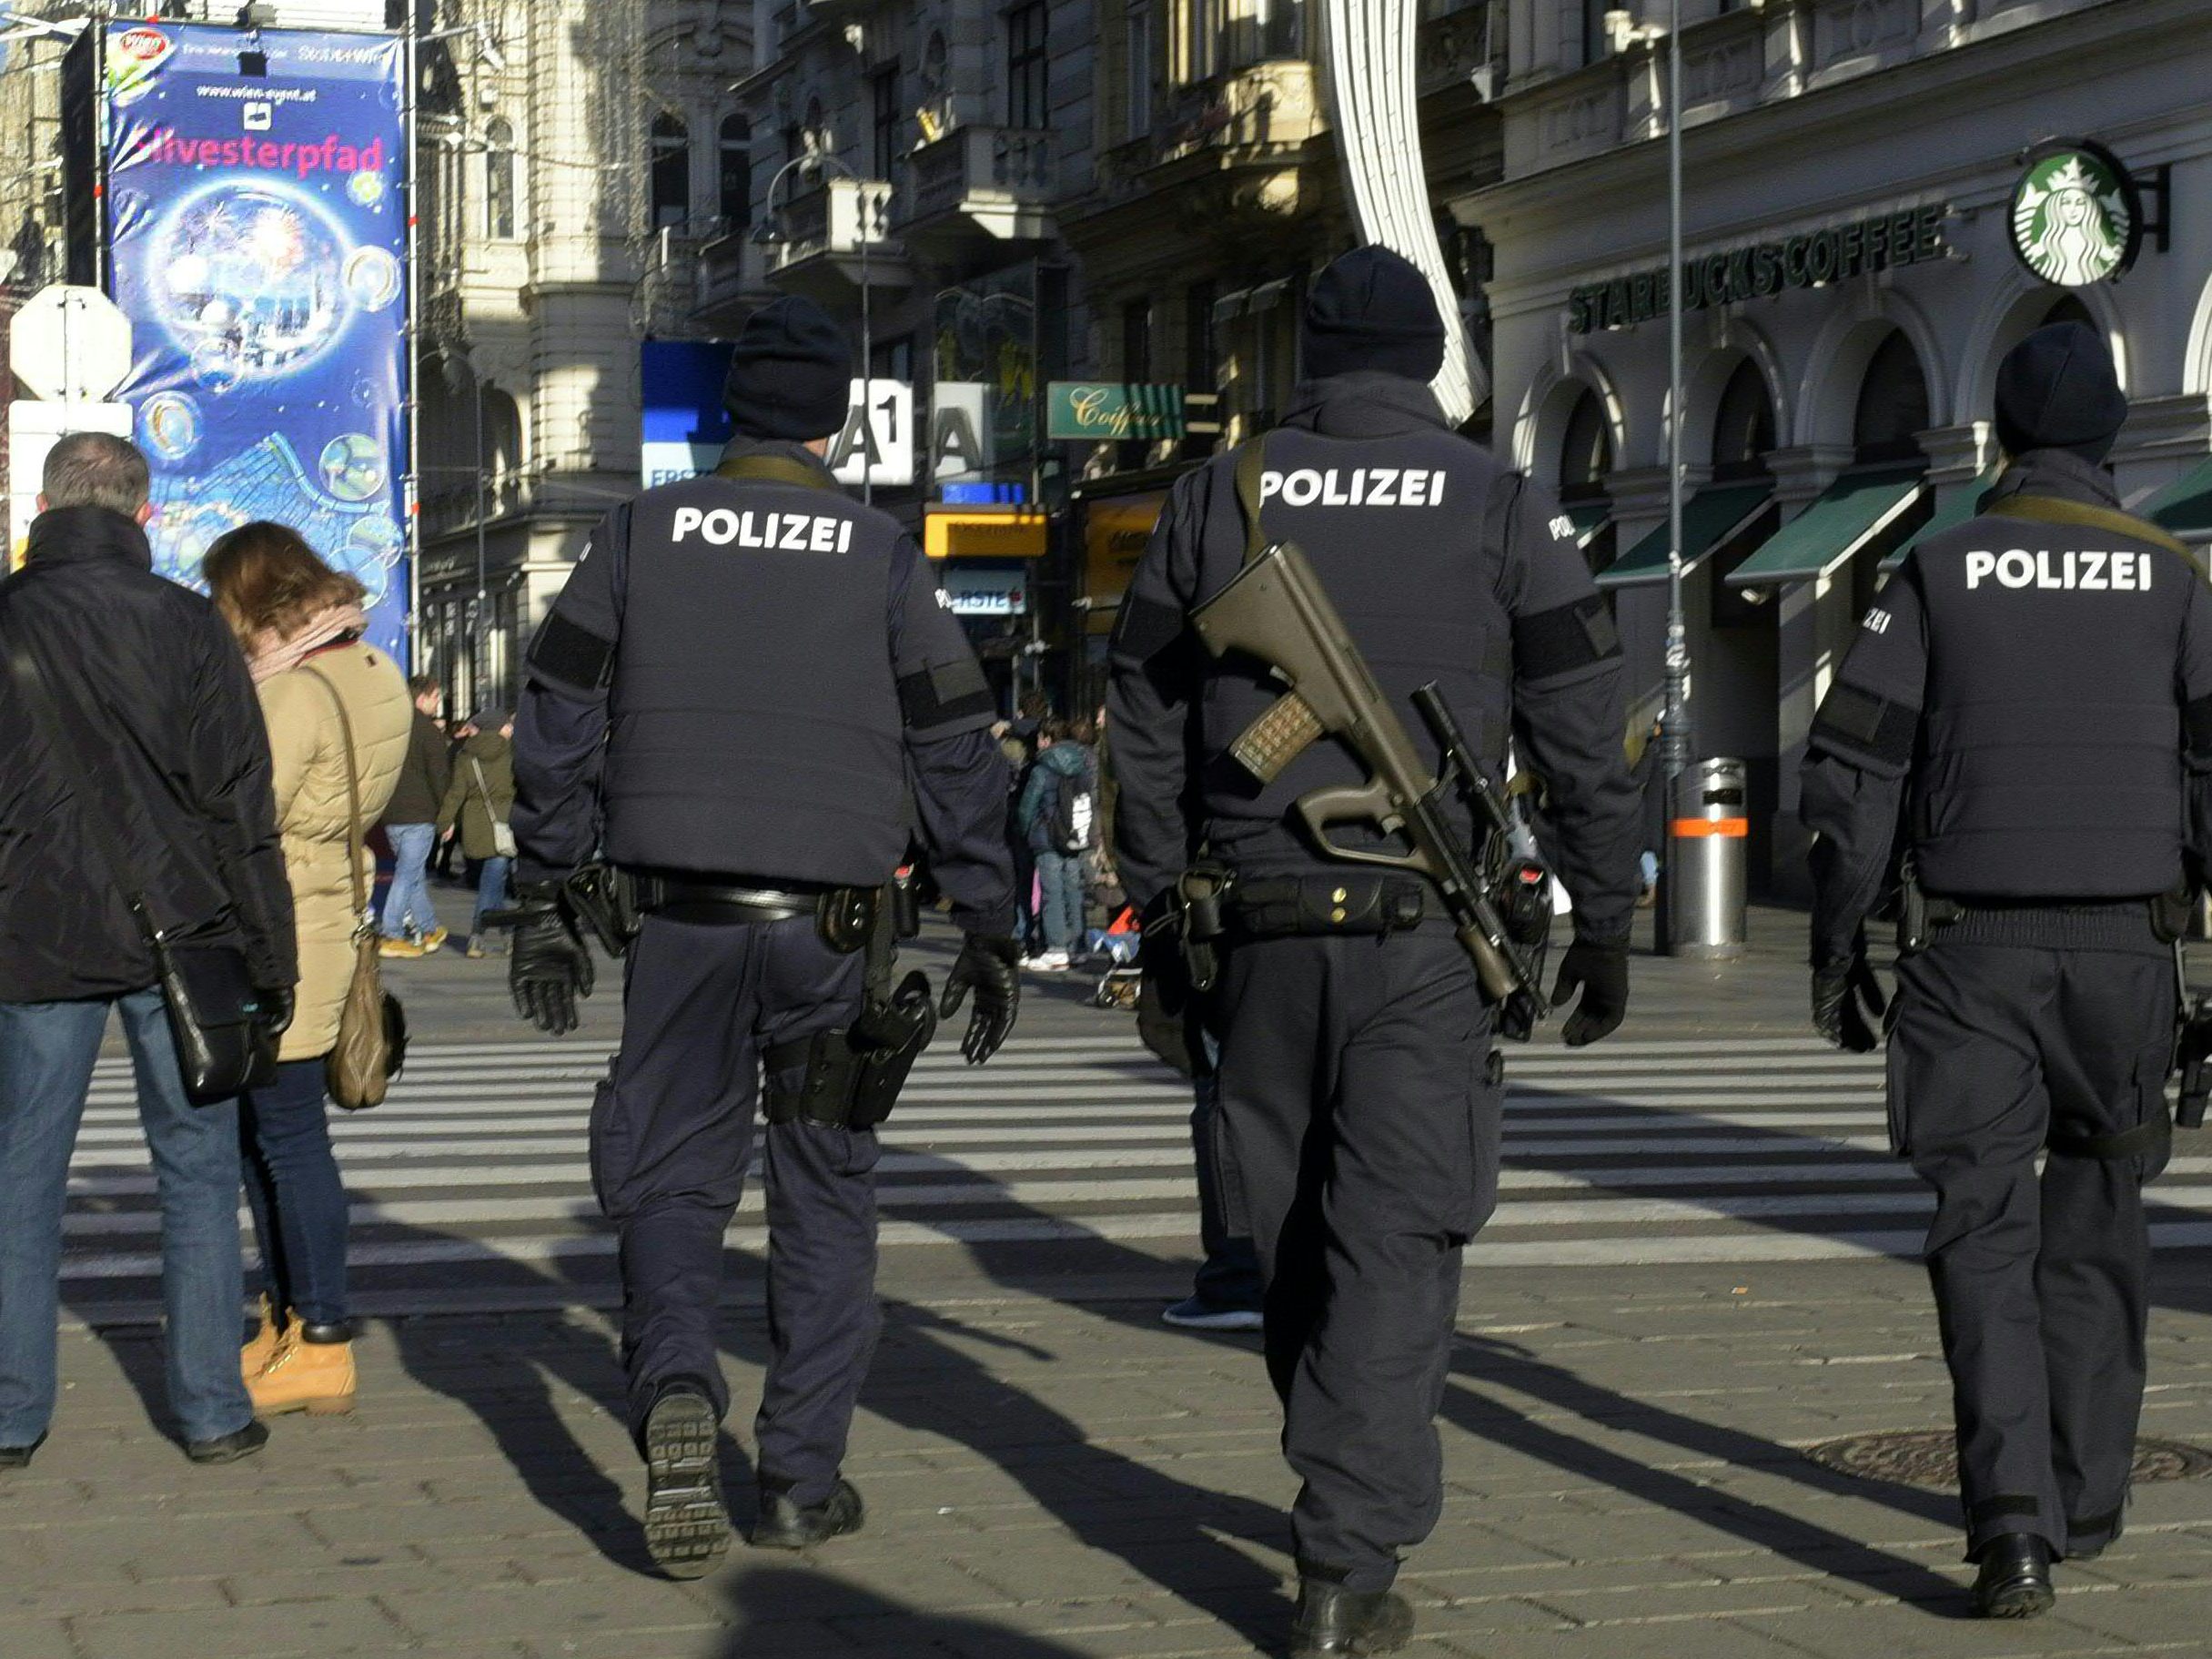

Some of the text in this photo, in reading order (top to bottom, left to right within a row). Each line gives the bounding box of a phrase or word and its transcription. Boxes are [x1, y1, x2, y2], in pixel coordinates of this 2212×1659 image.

[1567, 203, 1940, 334] STARBUCKS COFFEE
[831, 395, 897, 468] A1
[1258, 469, 1446, 509] POLIZEI
[672, 508, 853, 554] POLIZEI
[1965, 550, 2152, 591] POLIZEI
